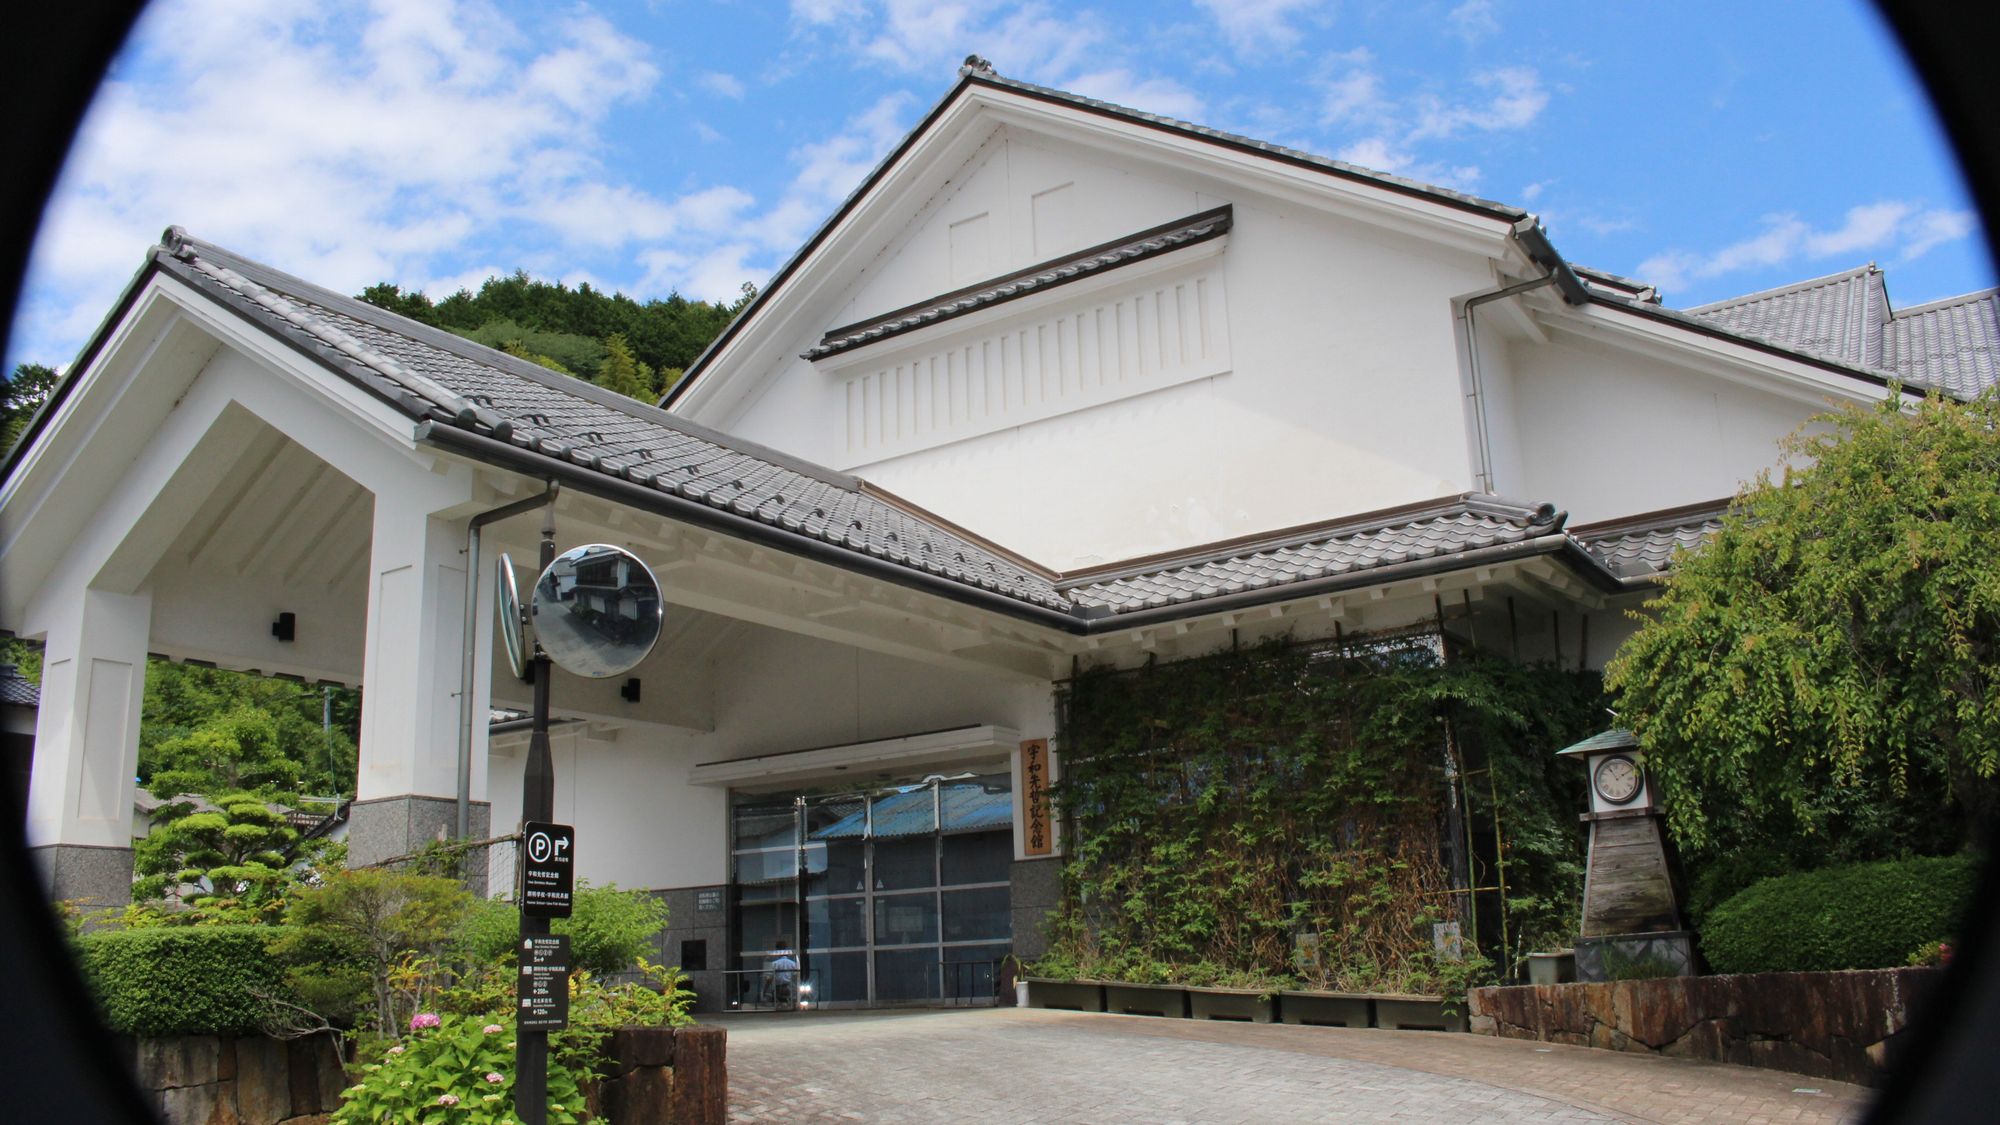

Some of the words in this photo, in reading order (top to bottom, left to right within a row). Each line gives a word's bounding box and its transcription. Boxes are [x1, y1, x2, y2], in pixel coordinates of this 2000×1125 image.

[1027, 744, 1044, 849] 宇和先哲記念館
